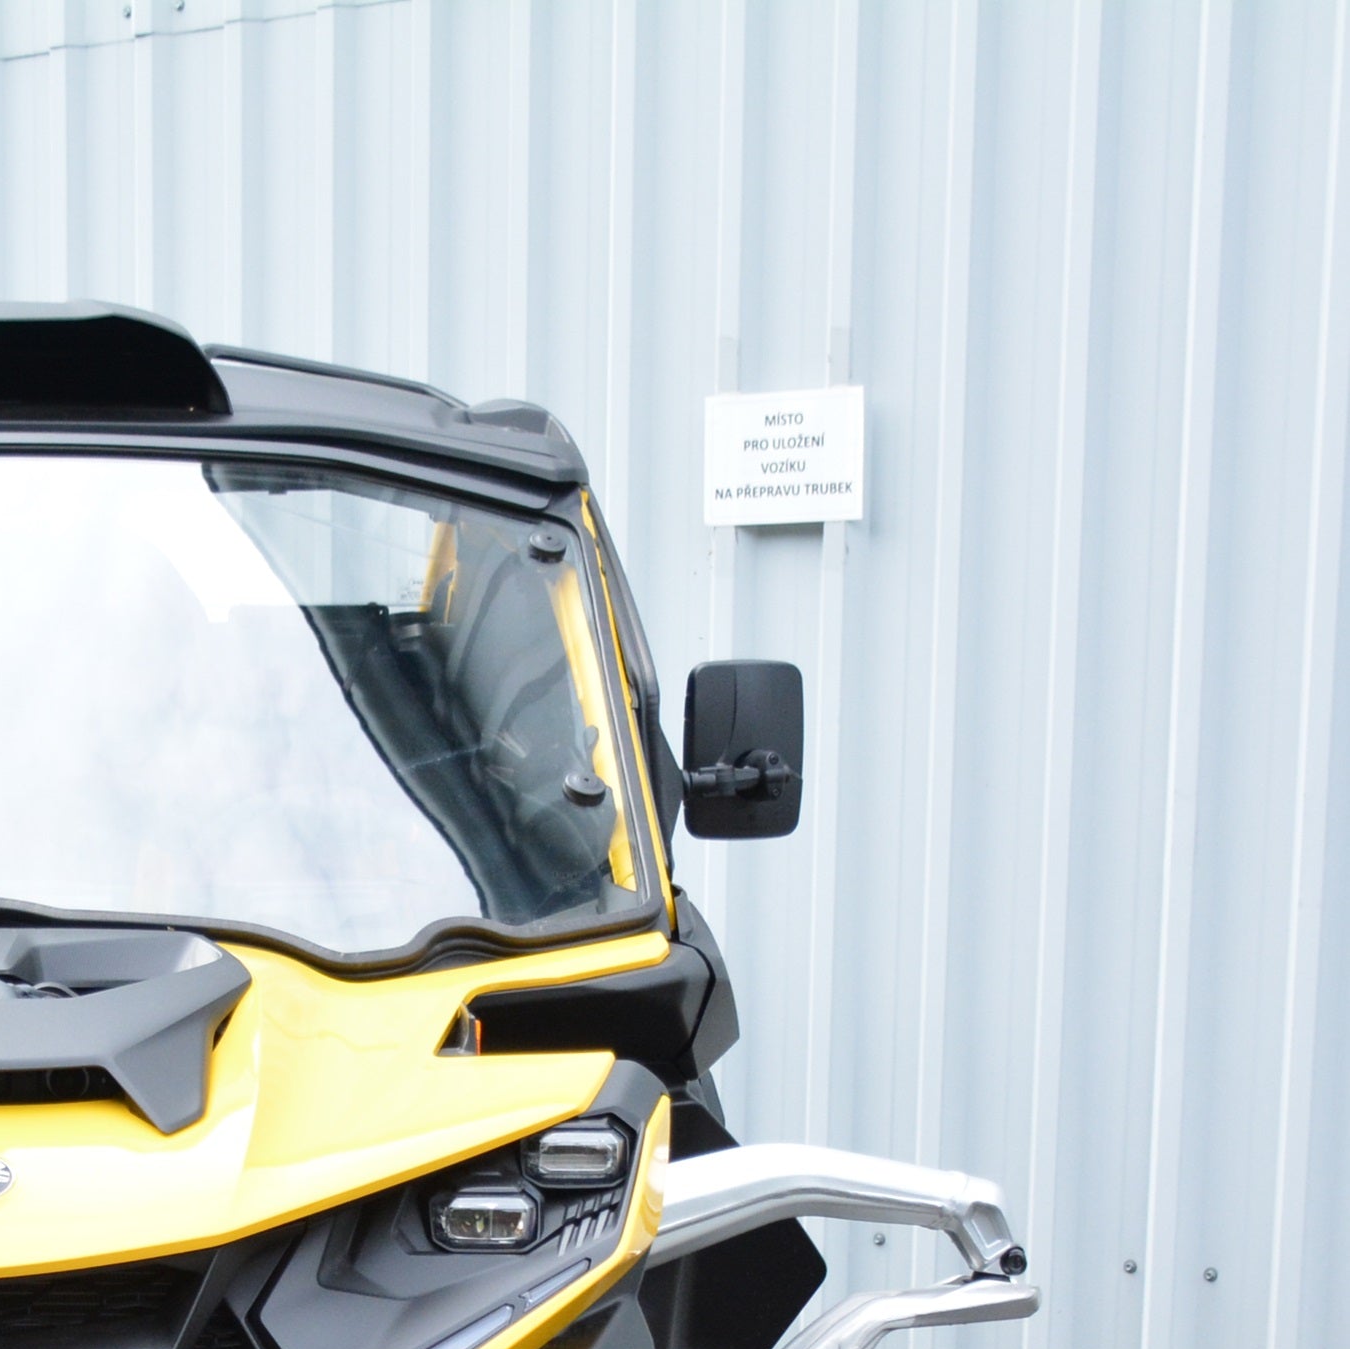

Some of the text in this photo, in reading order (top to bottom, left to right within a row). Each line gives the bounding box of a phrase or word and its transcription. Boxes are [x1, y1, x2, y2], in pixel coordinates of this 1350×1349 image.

[764, 412, 804, 427] MÍSTO
[743, 433, 825, 451] PRO ULOŽENÍ
[760, 459, 806, 474] VOZÍKU
[715, 482, 852, 500] NA PŘEPRAVU TRUBEK
